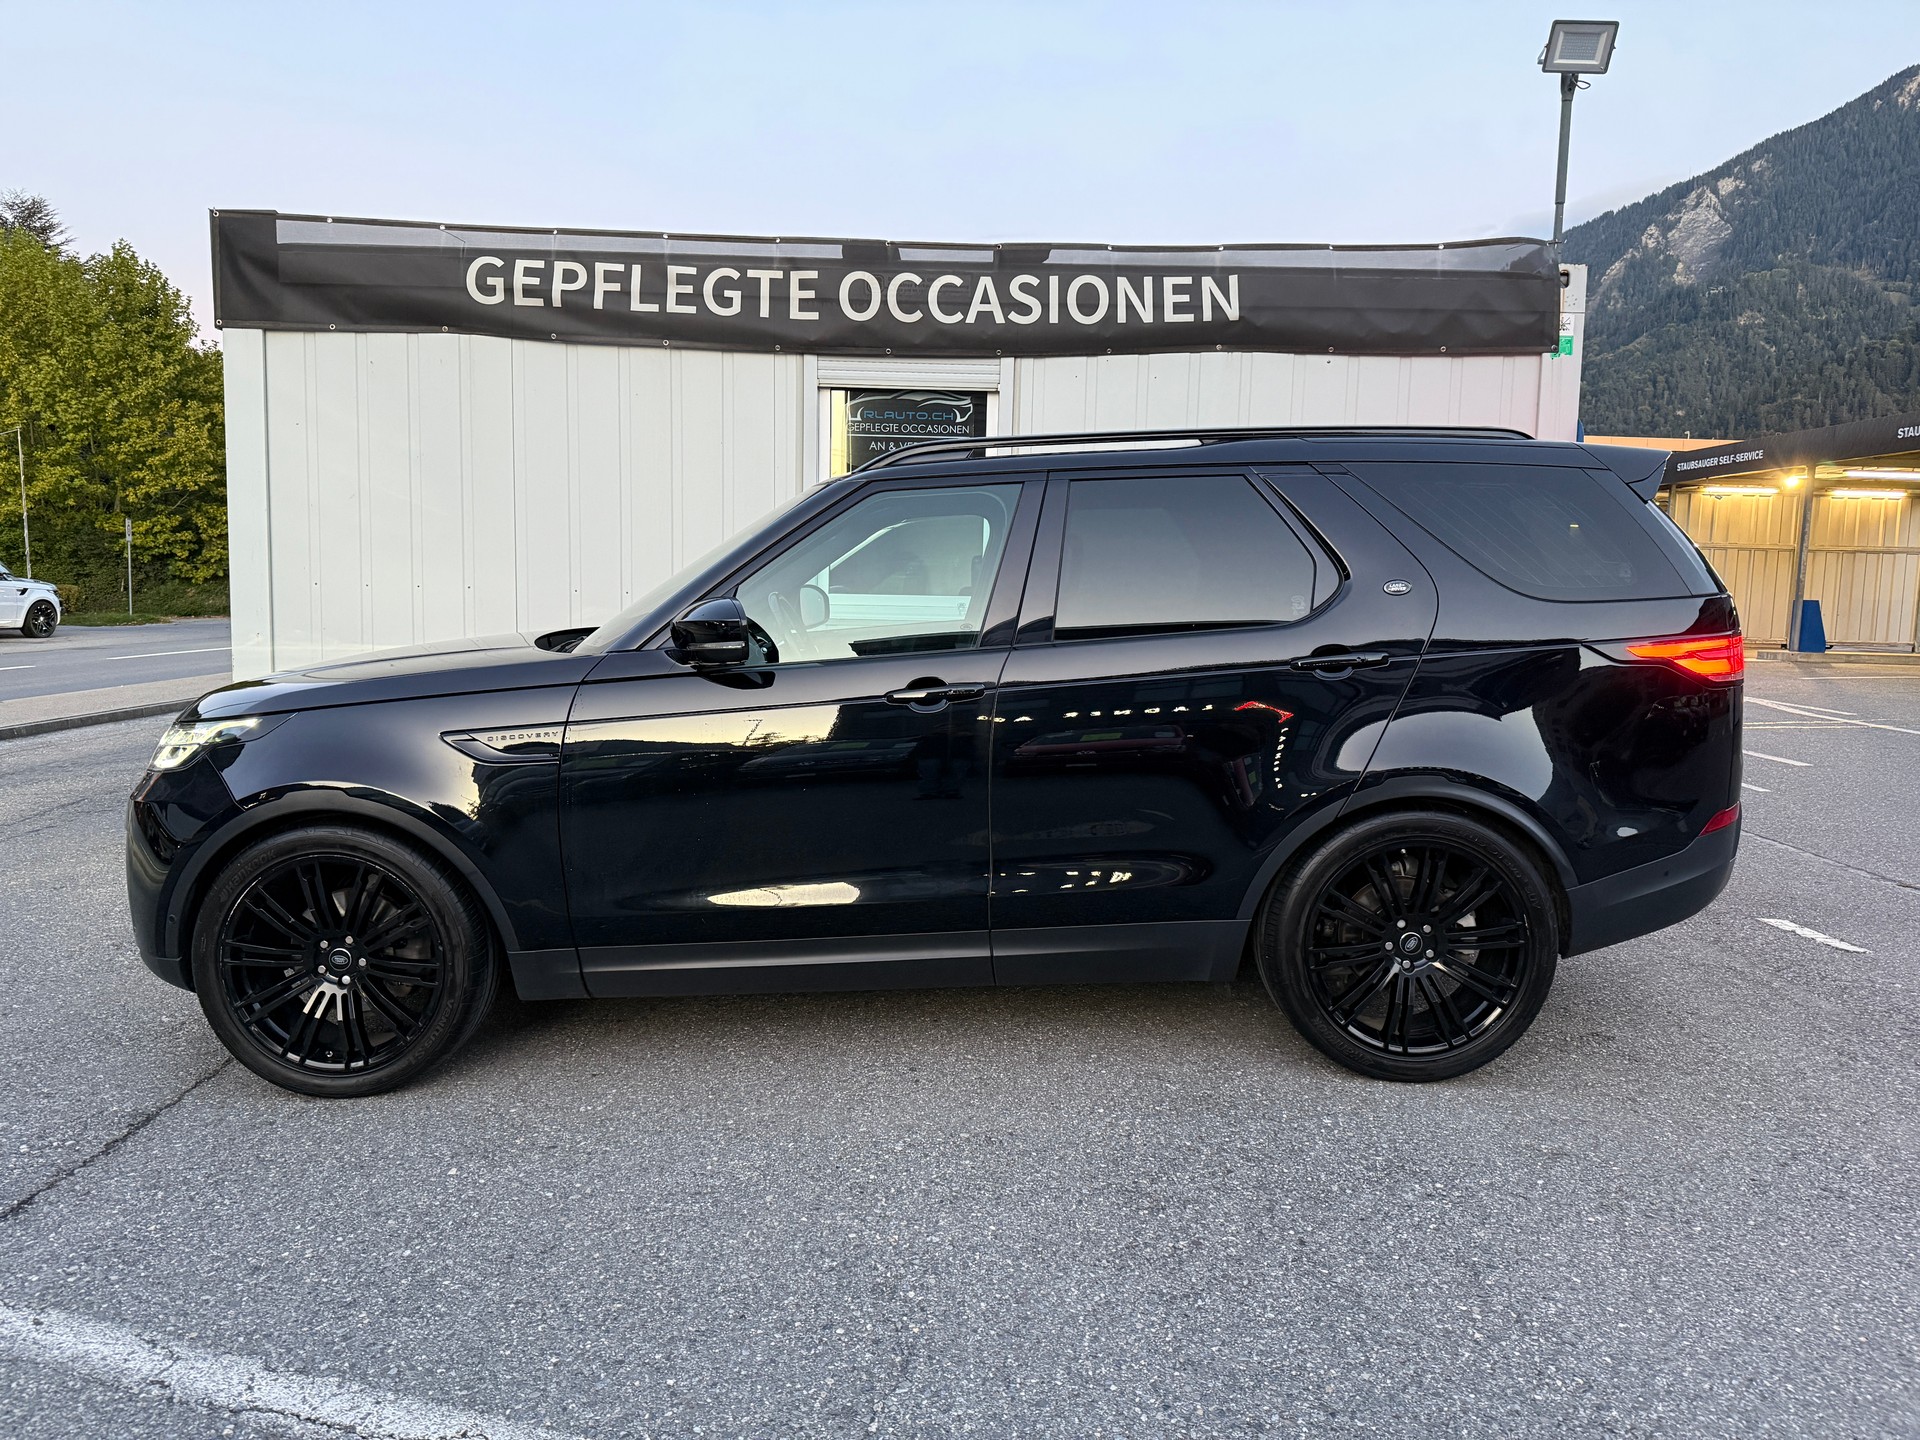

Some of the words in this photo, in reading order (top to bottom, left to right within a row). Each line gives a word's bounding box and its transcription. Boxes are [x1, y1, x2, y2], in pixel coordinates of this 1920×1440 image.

[465, 255, 820, 320] GEPFLEGTE
[838, 270, 1240, 325] OCCASIONEN
[863, 410, 955, 420] RLAUTO.CH
[847, 422, 899, 433] GEPFLEGTE
[901, 424, 970, 434] OCCASIONEN
[869, 441, 885, 450] AN
[888, 441, 896, 451] &
[1677, 457, 1718, 471] STAUBSAUGER
[1719, 450, 1764, 465] SELF-SERVICE
[487, 731, 559, 742] DISCOVERY
